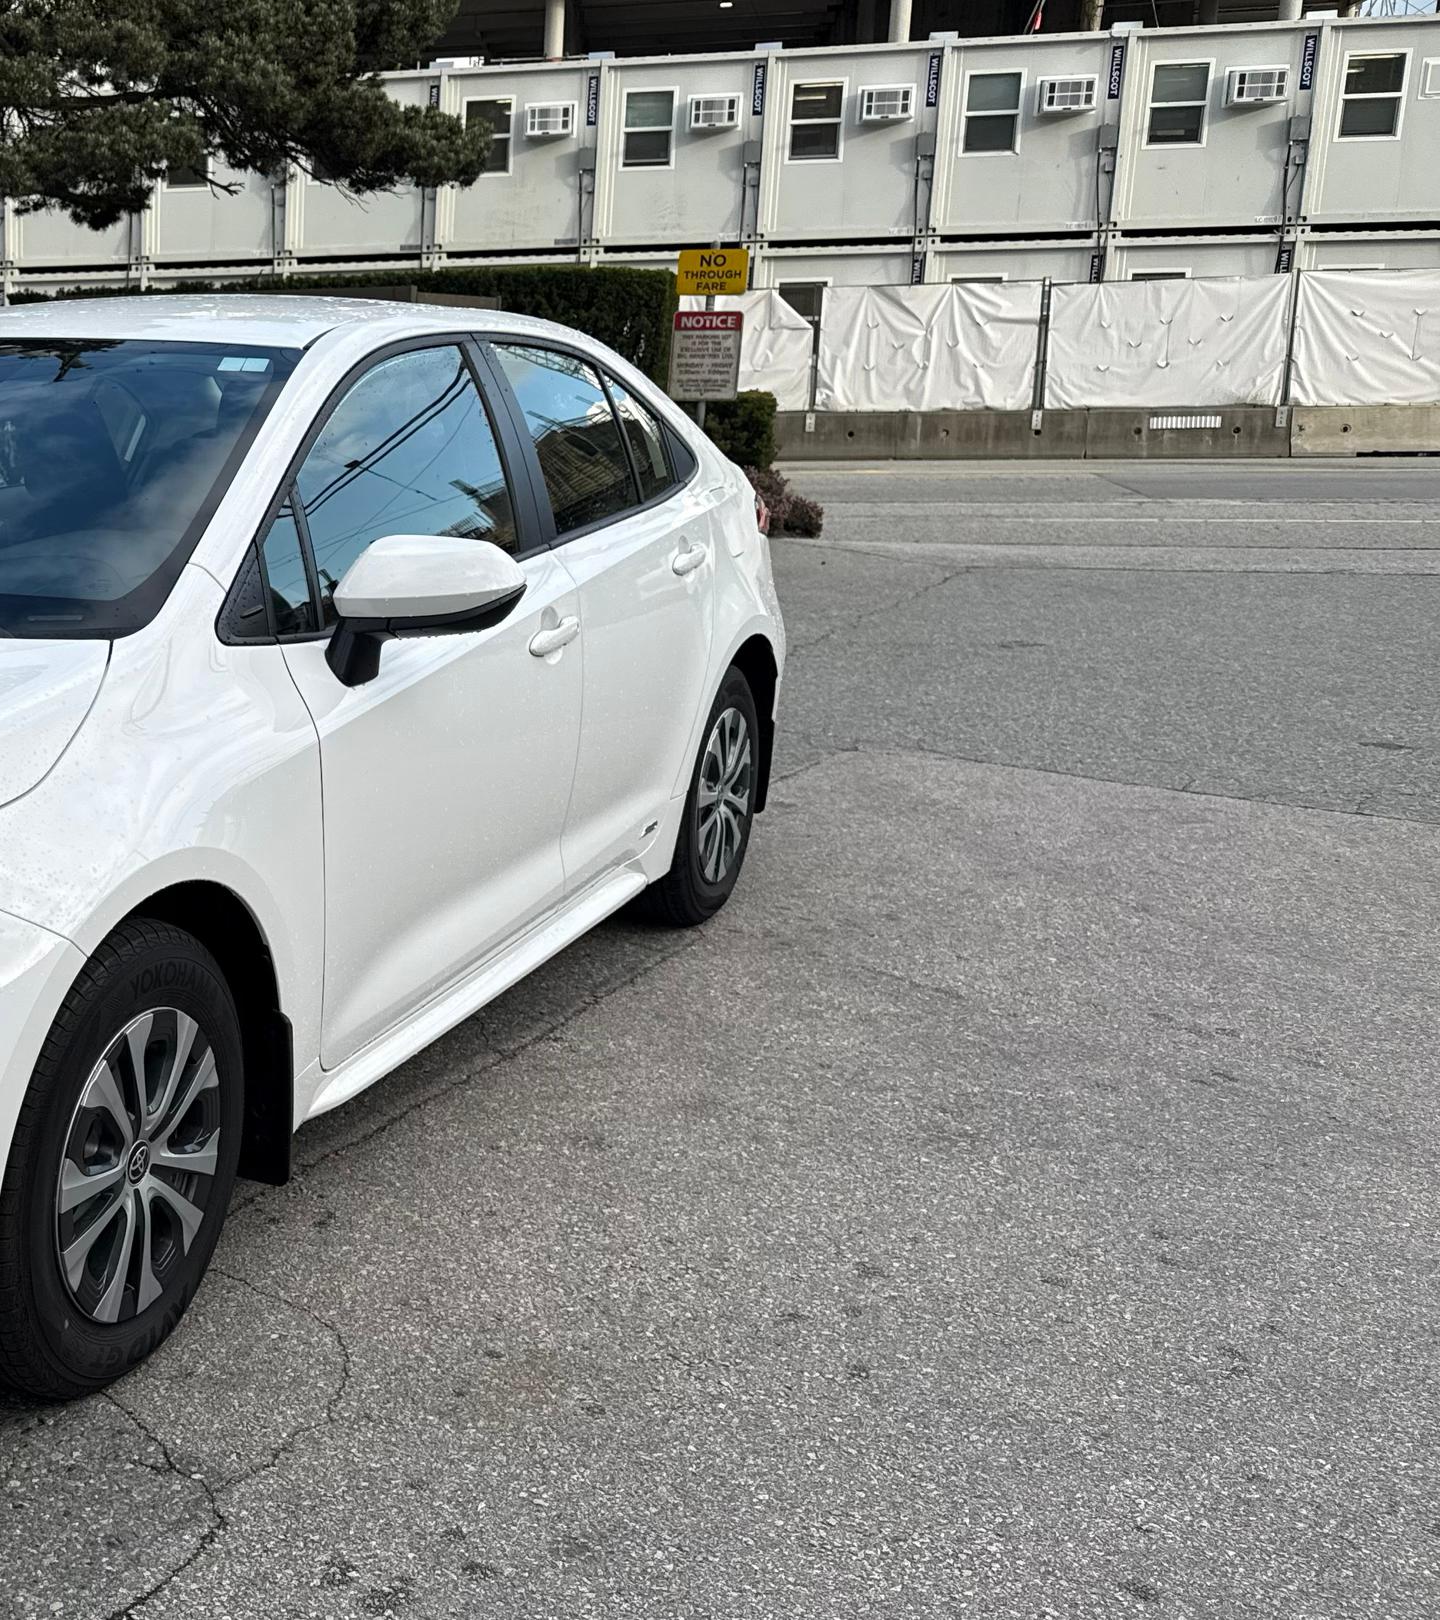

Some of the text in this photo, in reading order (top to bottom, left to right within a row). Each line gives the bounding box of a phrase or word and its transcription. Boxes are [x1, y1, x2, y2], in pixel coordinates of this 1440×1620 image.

[928, 57, 939, 104] WILLSCOT
[1110, 48, 1122, 97] WILLSCOT
[1302, 37, 1315, 86] WILLSCOT
[589, 78, 598, 122] WILLSCOT
[754, 66, 764, 113] WILLSCOT
[684, 270, 742, 279] THROUGH
[700, 254, 727, 267] NO
[696, 281, 727, 291] FARE
[681, 316, 737, 328] NOTICE
